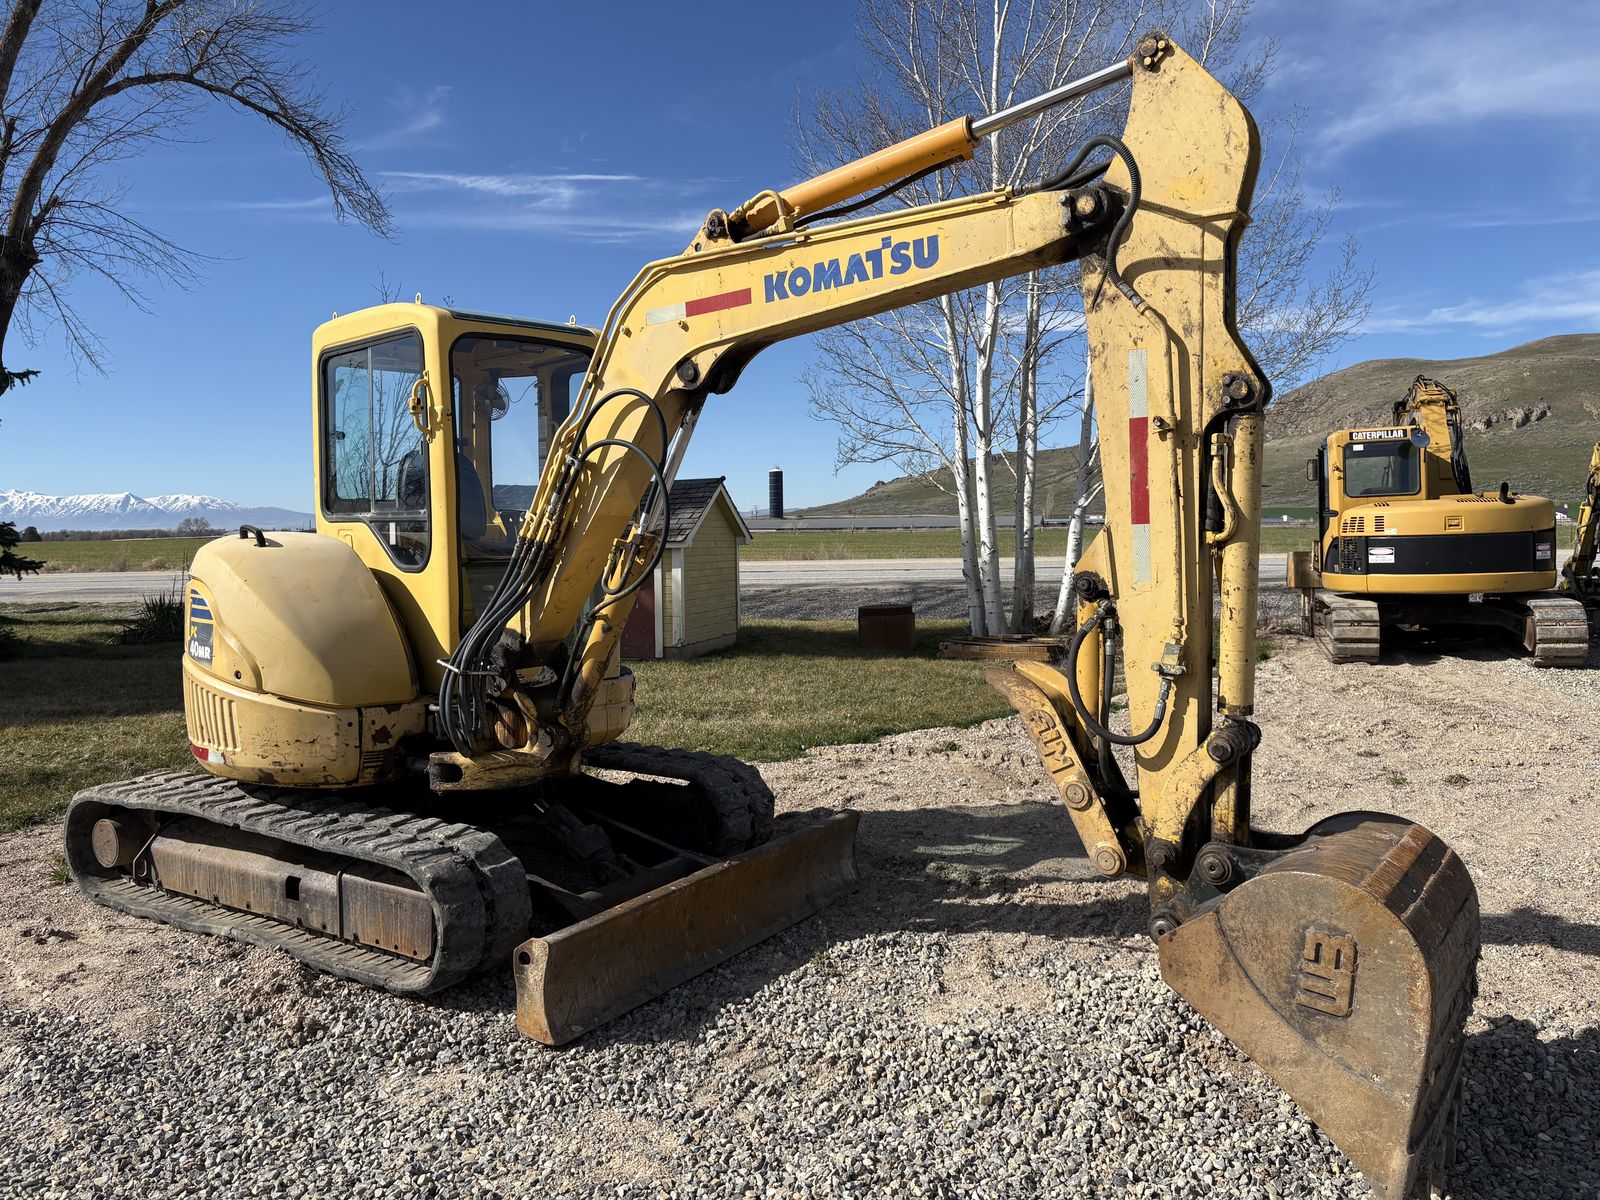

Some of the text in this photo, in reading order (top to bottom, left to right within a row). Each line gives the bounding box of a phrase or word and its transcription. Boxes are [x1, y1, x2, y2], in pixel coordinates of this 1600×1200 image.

[764, 234, 940, 304] KOMATSU
[1352, 429, 1404, 440] CATERPILLAR
[191, 625, 198, 638] PC
[189, 640, 212, 660] 40MR
